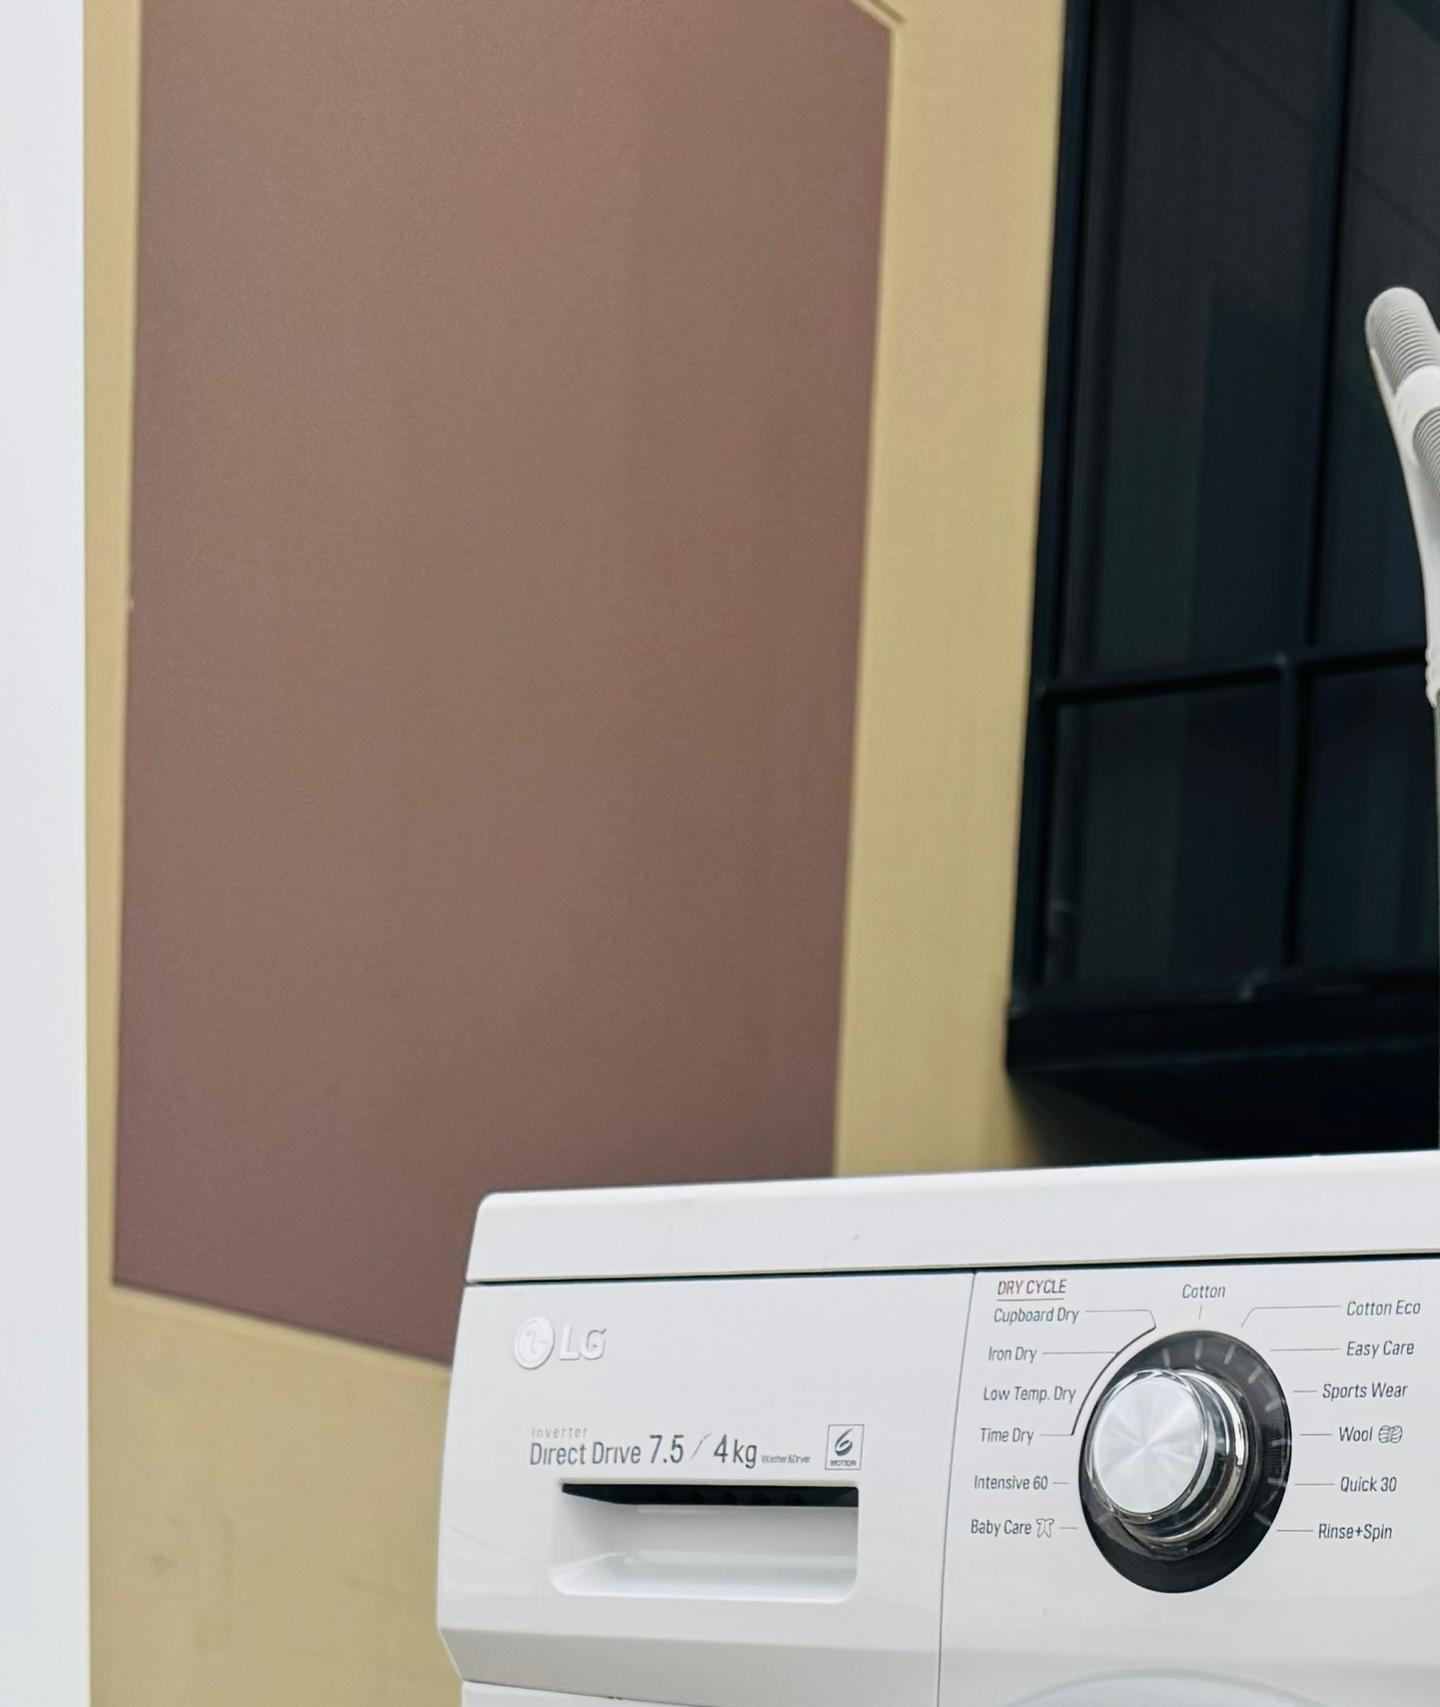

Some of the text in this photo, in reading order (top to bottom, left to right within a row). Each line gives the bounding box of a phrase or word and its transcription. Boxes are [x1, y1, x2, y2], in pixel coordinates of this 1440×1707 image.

[998, 1279, 1067, 1295] DRY CYCLE
[1182, 1284, 1226, 1299] Cotton
[1346, 1300, 1421, 1316] Cotton Eco
[994, 1307, 1079, 1326] Cupboard Dry
[559, 1324, 607, 1361] LG
[1347, 1341, 1415, 1358] Easy Care
[989, 1347, 1037, 1363] Iron Dry
[983, 1387, 1076, 1403] Low Temp. Dry
[1323, 1383, 1408, 1401] Sports Wear
[531, 1427, 588, 1439] Inverter
[981, 1428, 1034, 1444] Time Dry
[1339, 1427, 1372, 1441] Wool
[530, 1442, 586, 1465] Direct
[592, 1442, 641, 1464] Drive
[649, 1435, 684, 1463] 7.5
[974, 1475, 1048, 1490] Intensive 60
[1340, 1477, 1397, 1493] Quick 30
[971, 1520, 1032, 1537] Baby Care
[1318, 1524, 1393, 1542] Rinse+Spin
